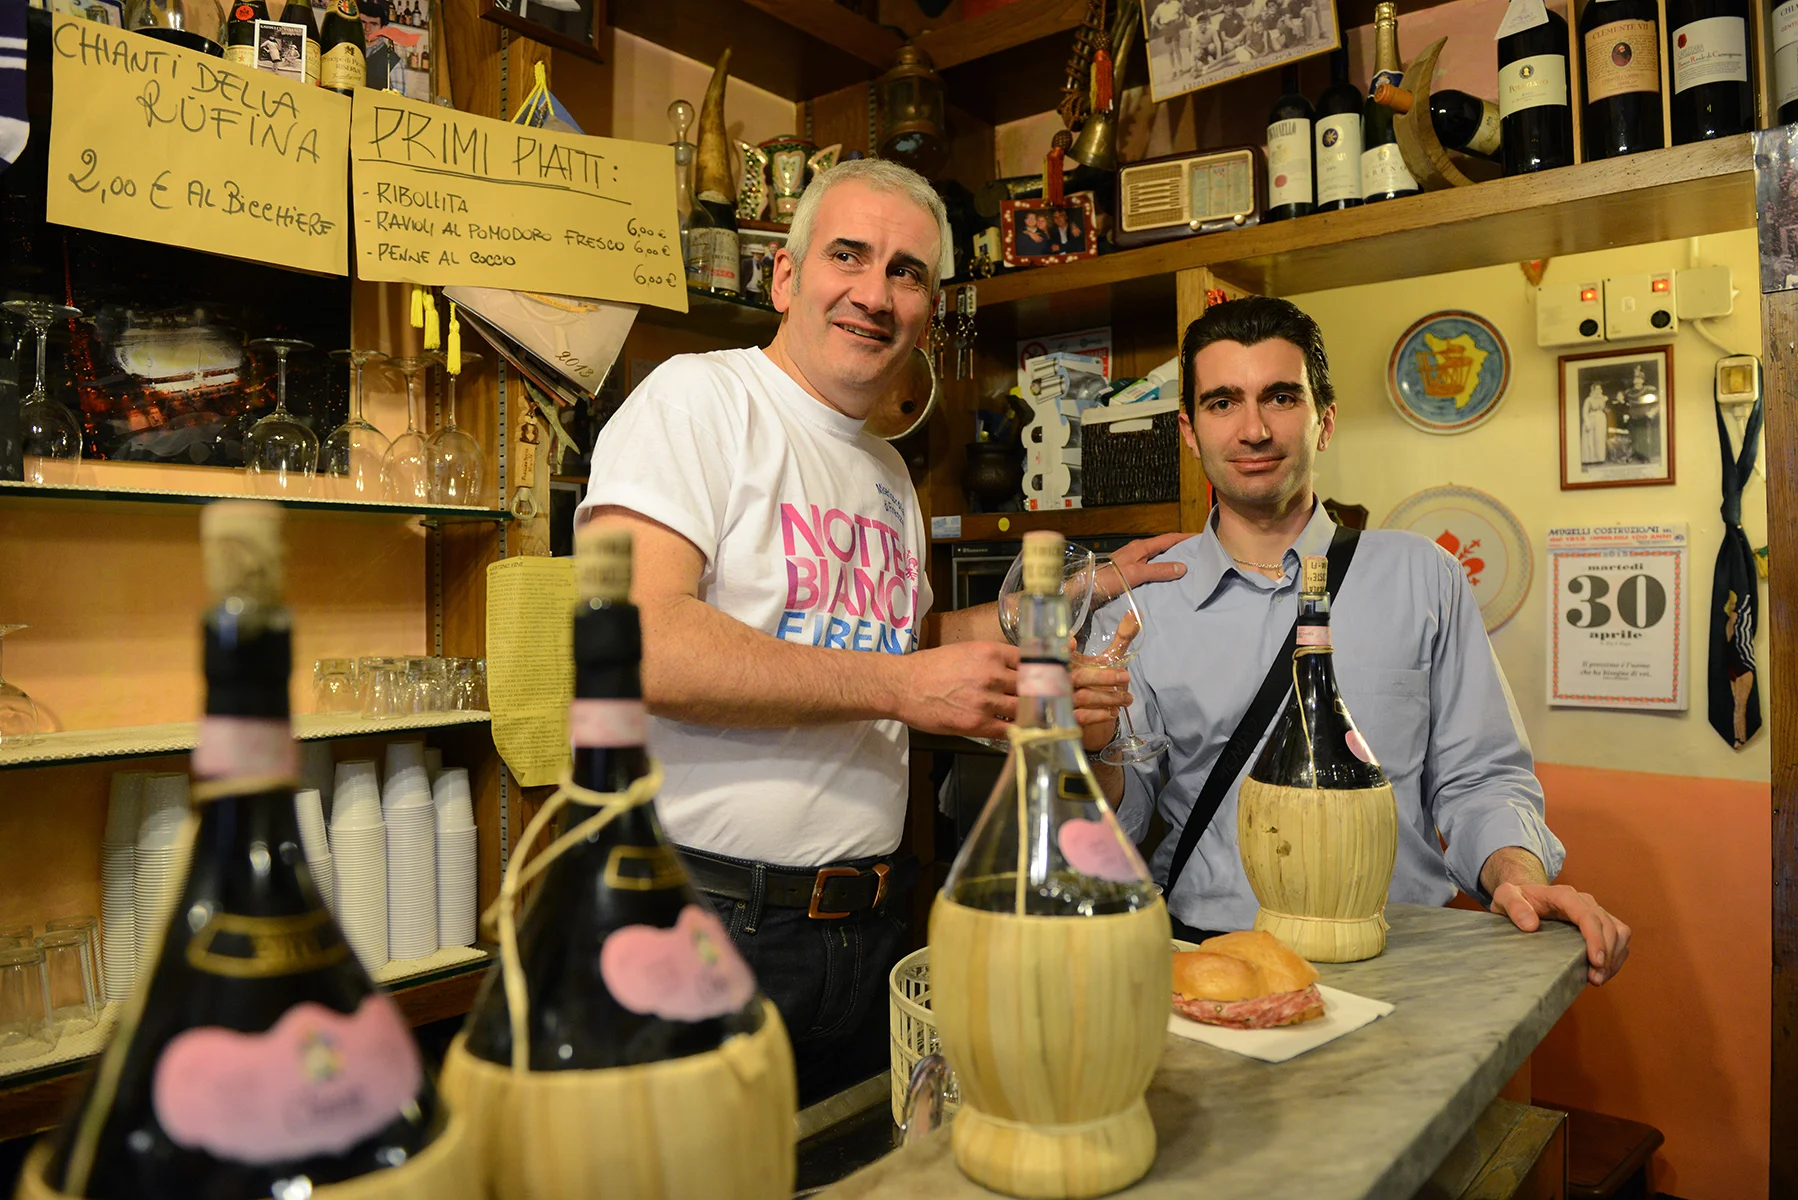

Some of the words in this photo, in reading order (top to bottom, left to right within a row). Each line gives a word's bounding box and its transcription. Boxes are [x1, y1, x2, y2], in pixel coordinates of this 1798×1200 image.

[1593, 23, 1636, 40] CLEMENTE
[53, 22, 183, 79] CHIANTI
[191, 61, 300, 119] DELLA
[368, 106, 488, 175] PRIMI
[68, 148, 136, 204] 2,00
[150, 170, 172, 209] €
[187, 179, 216, 208] AL
[377, 182, 468, 213] RIBOLLITA
[377, 211, 434, 237] RAVIOLI
[442, 221, 461, 236] AL
[469, 223, 552, 242] POMODORO
[564, 229, 625, 252] FRESCO
[377, 243, 430, 264] PENNE
[438, 250, 459, 265] AL
[555, 350, 596, 378] 2013
[780, 502, 906, 580] NOTTE
[1594, 526, 1659, 535] COSTRUZIONI
[1566, 574, 1666, 629] 30
[1590, 630, 1643, 641] aprile
